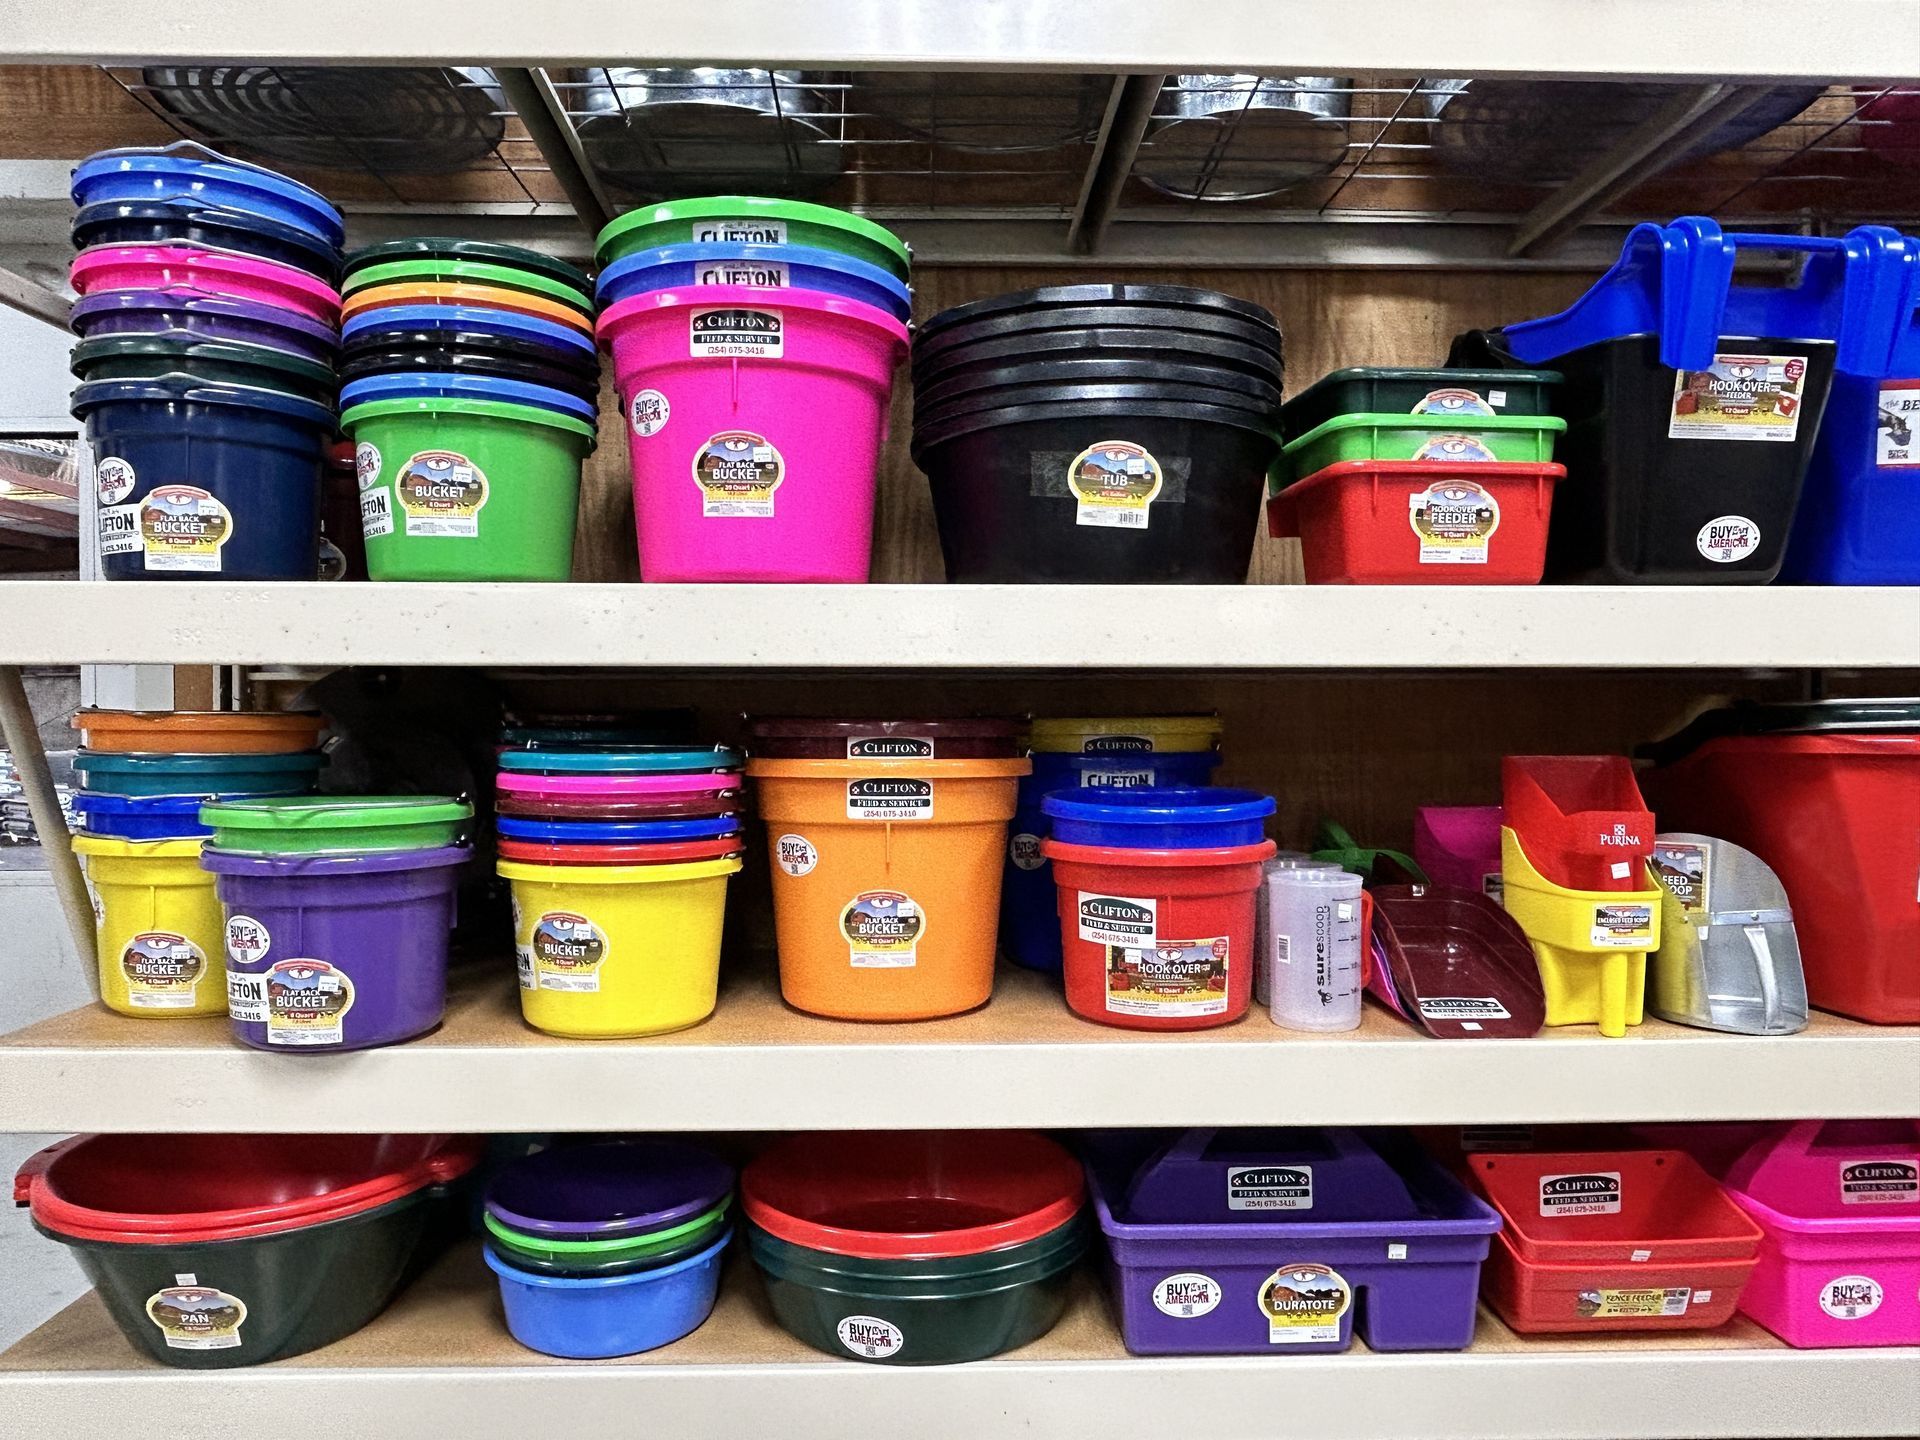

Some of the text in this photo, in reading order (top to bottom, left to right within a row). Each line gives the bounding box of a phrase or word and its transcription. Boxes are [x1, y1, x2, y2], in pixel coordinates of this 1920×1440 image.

[703, 270, 781, 287] CLIFTON
[707, 316, 764, 328] CLIFTON
[734, 335, 772, 343] SERVICE
[1709, 381, 1770, 392] HOOK OVER
[713, 469, 761, 480] BUCKET
[1102, 475, 1128, 486] TUB
[415, 485, 465, 498] BUCKET
[1431, 513, 1477, 523] FEEDER
[153, 523, 207, 534] BUCKET
[1710, 526, 1731, 539] BUY
[1708, 537, 1748, 548] AMERICAN
[864, 743, 917, 754] CLIFTON
[1097, 741, 1142, 750] CLIFTON
[1088, 774, 1149, 787] CLIFTON
[863, 782, 917, 793] CLIFTON
[857, 799, 878, 807] FEED
[880, 799, 886, 807] &
[1600, 834, 1640, 847] PURINA
[1663, 876, 1688, 885] FEED
[1670, 885, 1693, 895] OOP
[1089, 902, 1140, 919] CLIFTON
[859, 924, 905, 934] BUCKET
[1086, 919, 1145, 933] FEED & SERVICE
[544, 944, 587, 956] BUCKET
[1316, 906, 1326, 986] surescoop
[136, 965, 183, 975] BUCKET
[1138, 964, 1200, 973] HOOK OVER
[276, 996, 328, 1007] BUCKET
[1244, 1173, 1296, 1184] CLIFTON
[1855, 1168, 1904, 1178] CLIFTON
[1555, 1180, 1605, 1191] CLIFTON
[1167, 1283, 1190, 1295] BUY
[1833, 1286, 1853, 1298] BUY
[1166, 1293, 1209, 1305] AMERICAN
[1274, 1300, 1335, 1311] DURATOTE
[181, 1314, 209, 1323] PAN
[849, 1323, 871, 1337] BUY
[849, 1333, 892, 1347] AMERICAN
